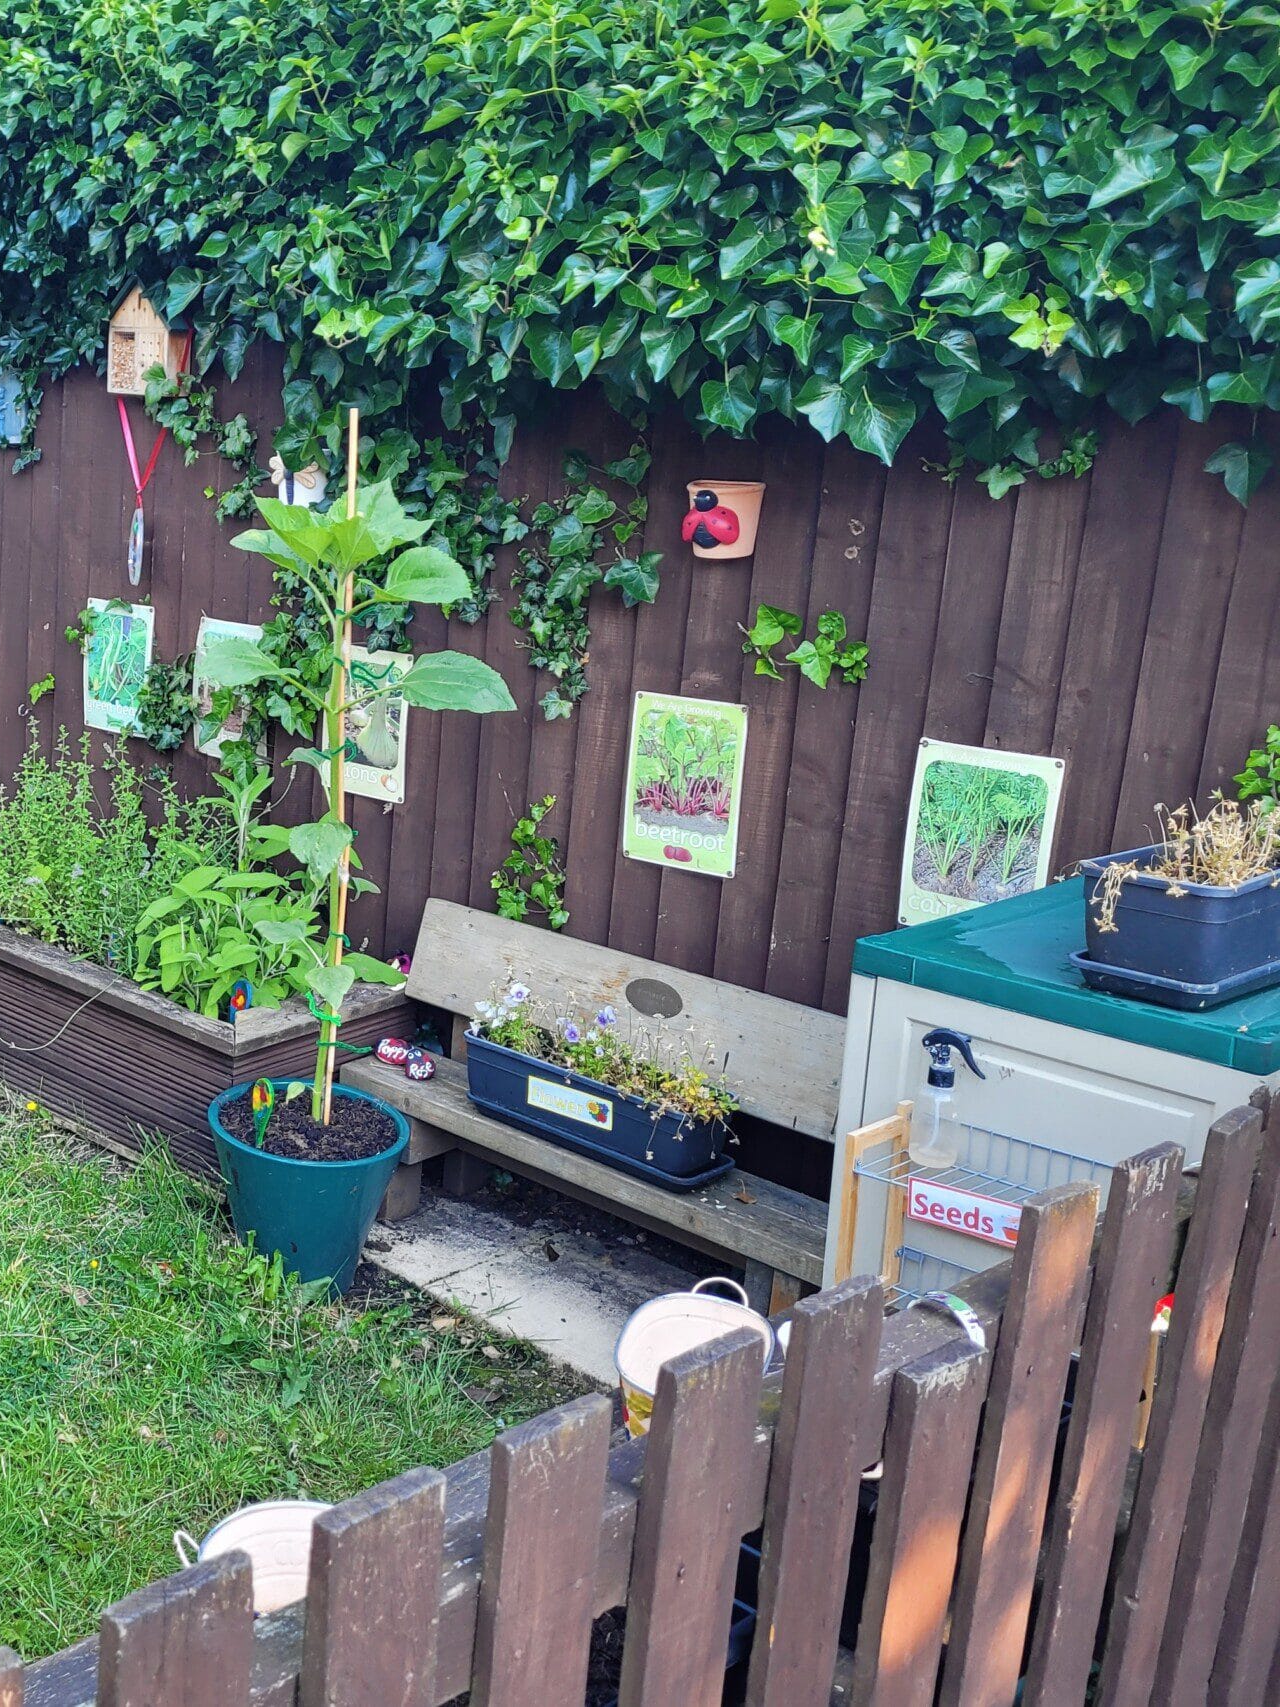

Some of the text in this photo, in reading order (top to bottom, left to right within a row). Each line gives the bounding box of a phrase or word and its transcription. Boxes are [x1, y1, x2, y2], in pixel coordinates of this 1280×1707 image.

[635, 815, 726, 852] beetroot
[378, 1038, 414, 1060] Poppy
[409, 1061, 435, 1080] Rose
[914, 1193, 994, 1234] Seeds
